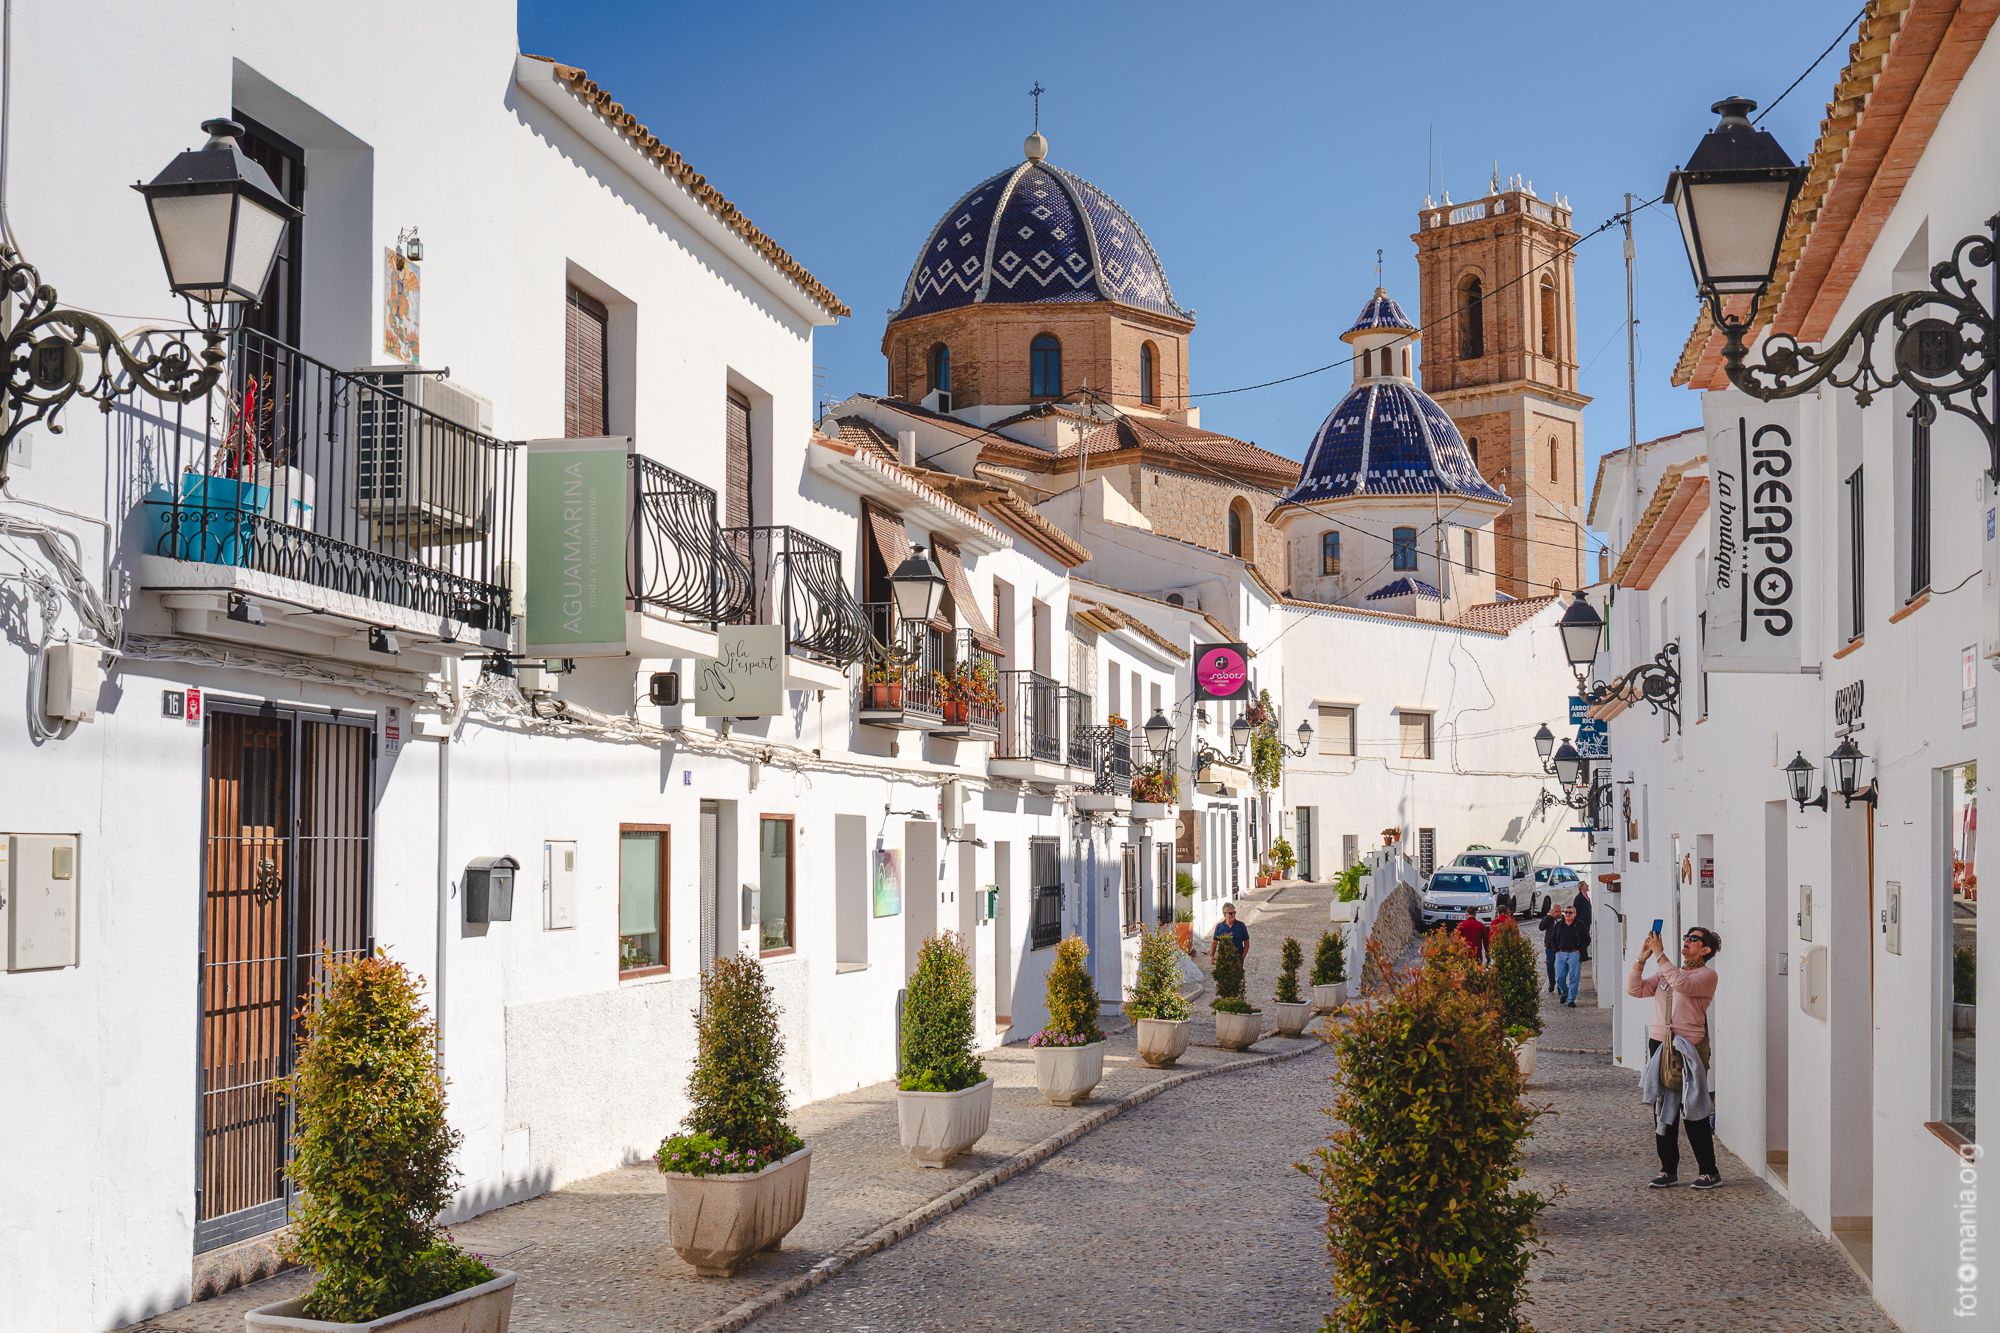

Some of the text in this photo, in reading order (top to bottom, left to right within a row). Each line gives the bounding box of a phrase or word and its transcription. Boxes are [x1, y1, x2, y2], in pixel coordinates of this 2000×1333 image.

[563, 461, 583, 634] AGUAMARINA
[587, 487, 600, 608] moda y complementos
[1717, 469, 1737, 589] La boutique
[1752, 424, 1794, 637] CREAPOP
[169, 693, 179, 715] 16
[1209, 671, 1246, 680] sabors
